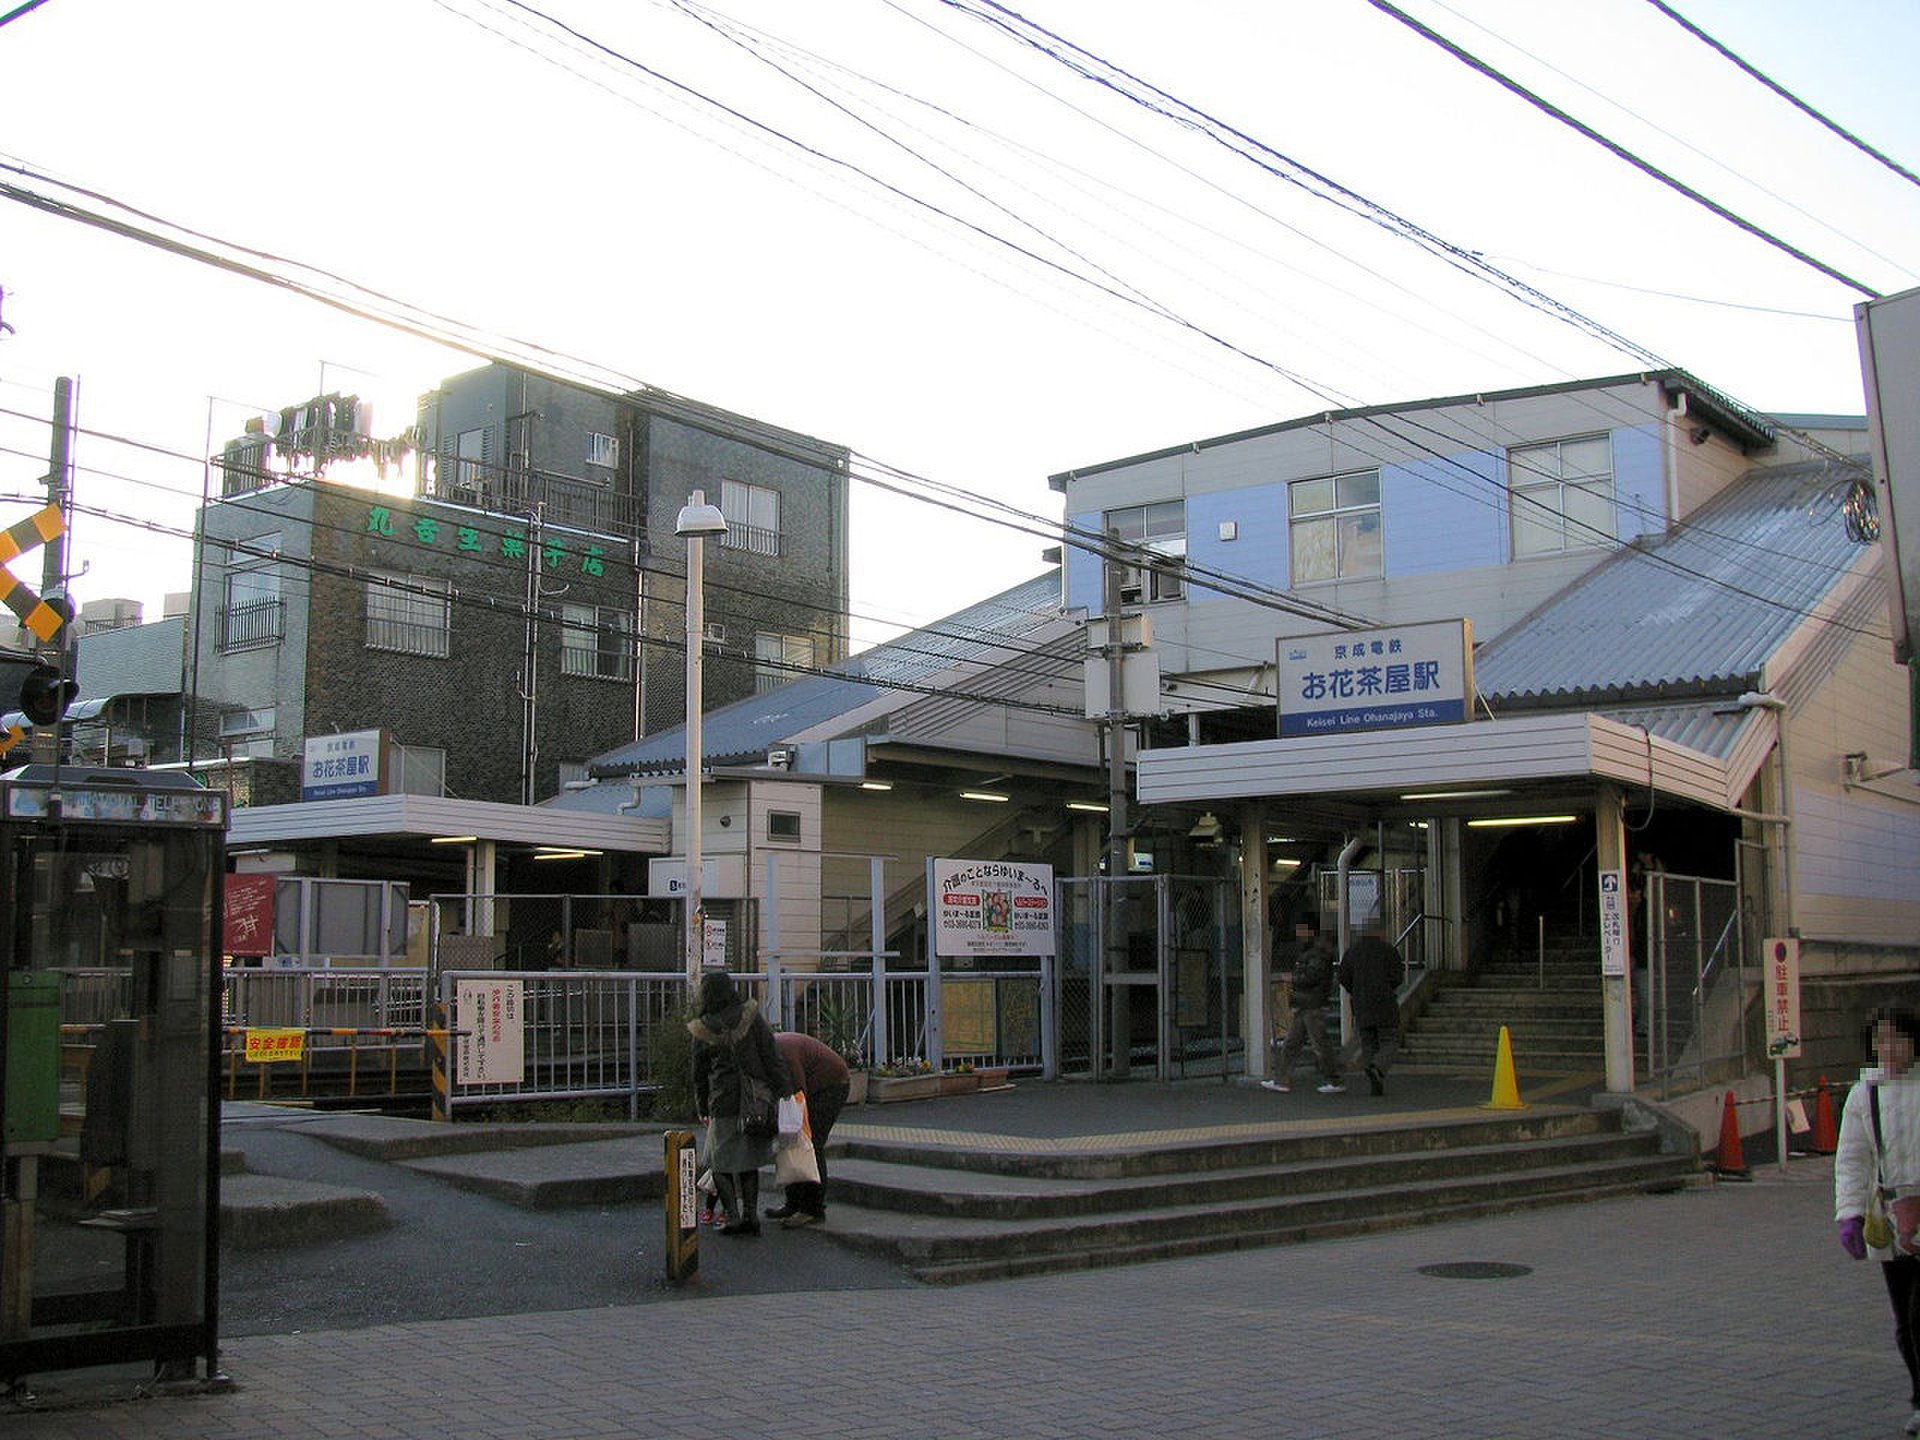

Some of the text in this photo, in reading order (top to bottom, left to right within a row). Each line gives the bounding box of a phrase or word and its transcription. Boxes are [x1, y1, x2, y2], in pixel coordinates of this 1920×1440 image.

[1334, 639, 1402, 660] 京成電鉄
[1302, 660, 1440, 700] お花茶屋駅
[1307, 708, 1439, 728] Keisei Line Ohanajaya Sta.
[313, 755, 370, 778] お花茶屋駅
[1776, 964, 1789, 1031] 駐車禁止
